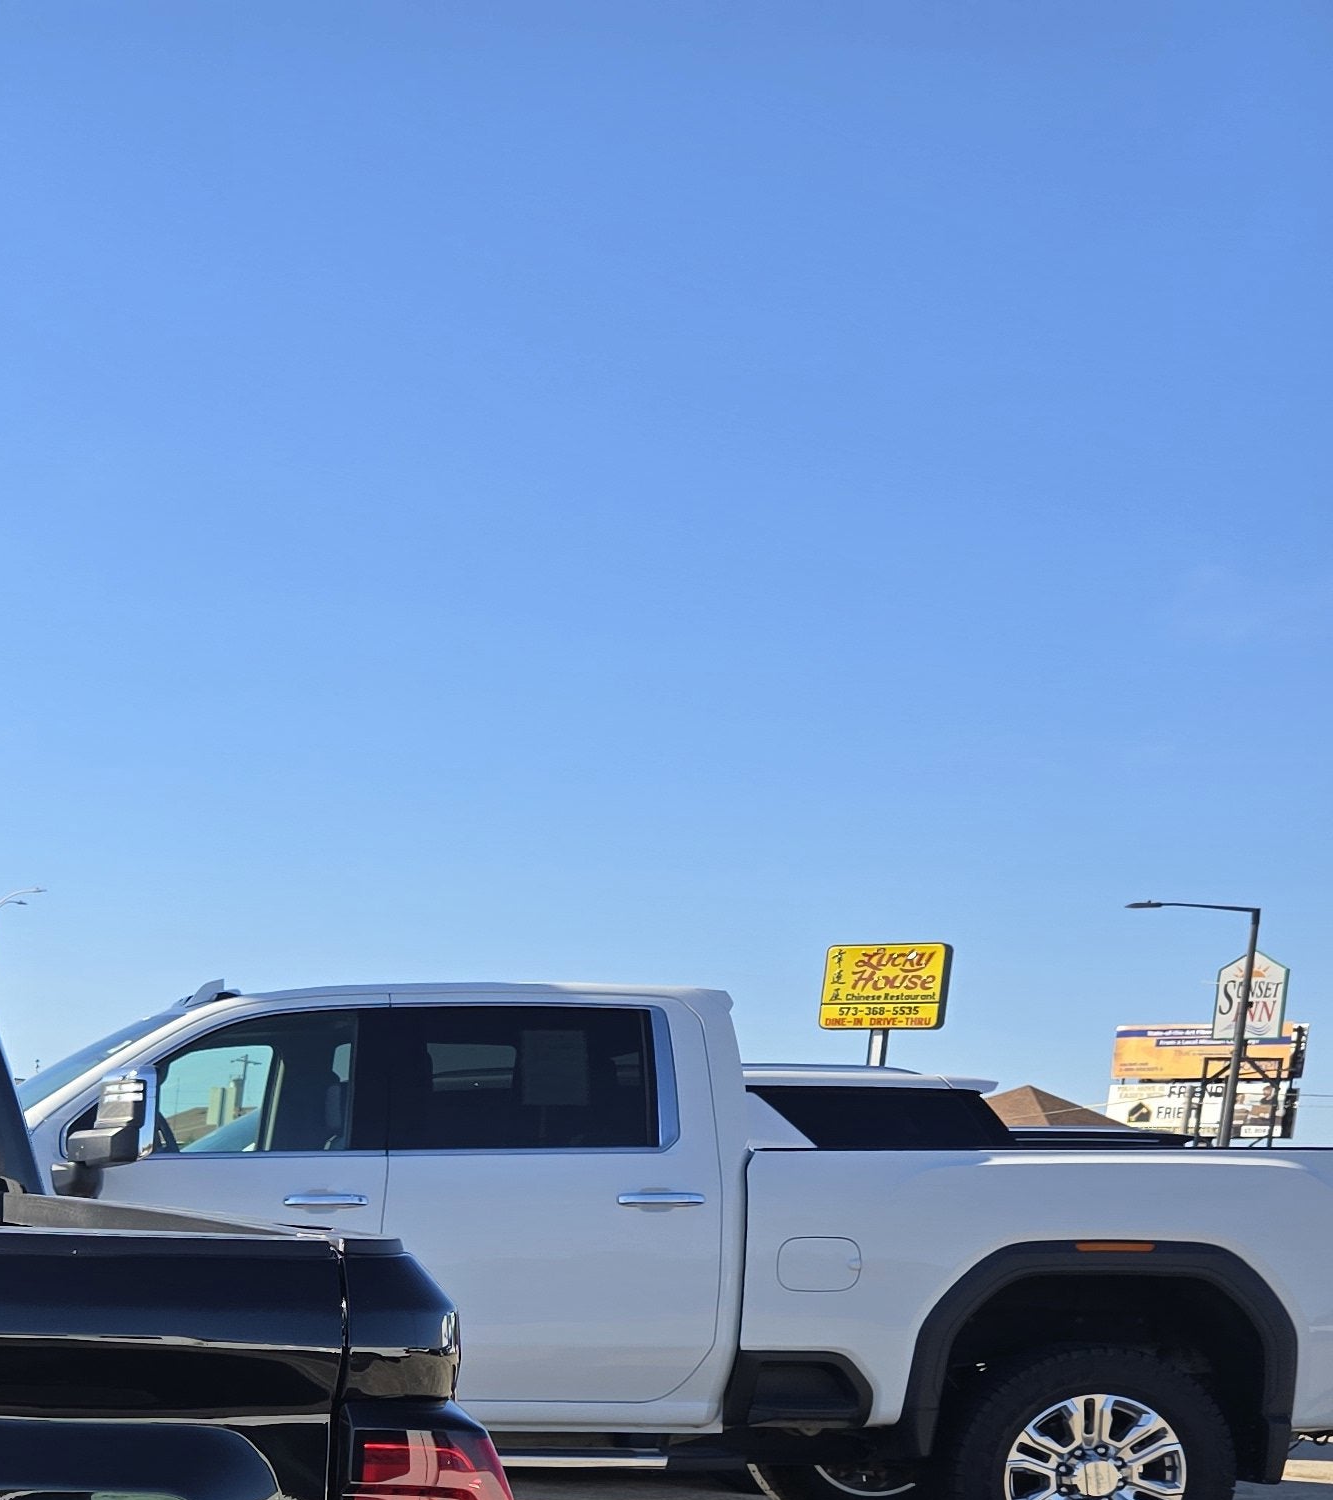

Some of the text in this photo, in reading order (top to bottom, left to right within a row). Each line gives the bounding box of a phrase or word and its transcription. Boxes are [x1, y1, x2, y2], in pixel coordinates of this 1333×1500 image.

[854, 947, 937, 973] Lucky
[851, 969, 936, 992] House
[845, 991, 936, 1001] Chinese Restaurant
[838, 1005, 920, 1016] 573-368-5535
[825, 1017, 932, 1026] DINE-IN DRIVE-THRU
